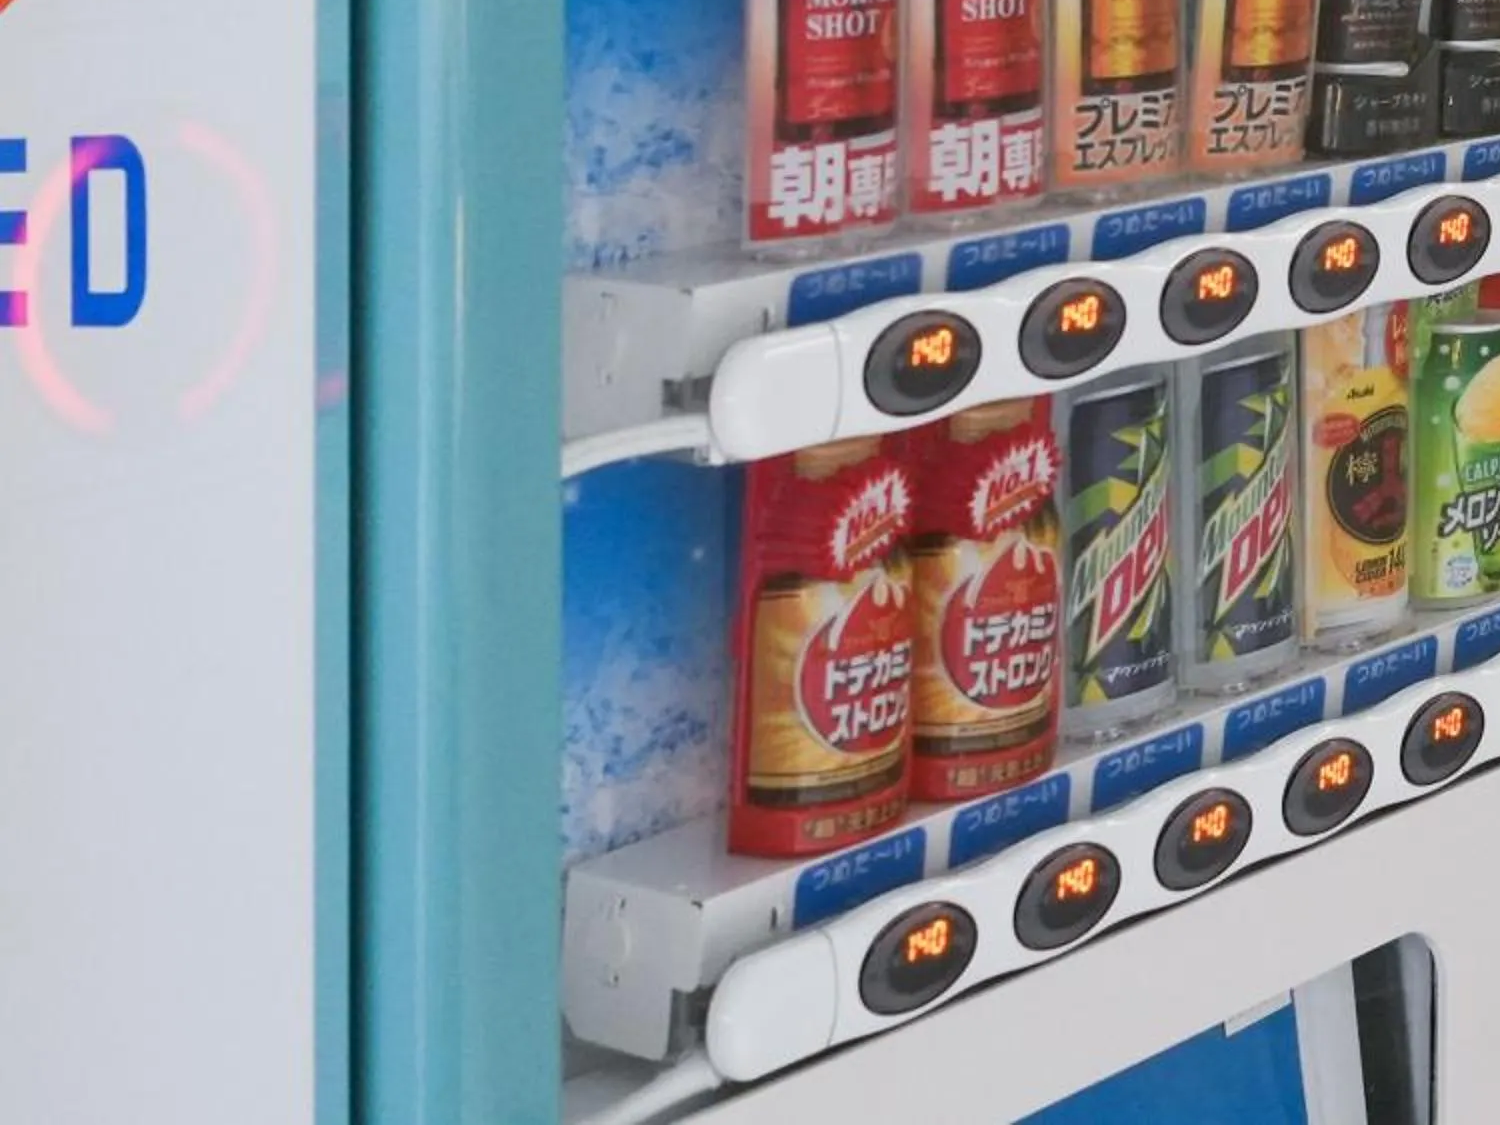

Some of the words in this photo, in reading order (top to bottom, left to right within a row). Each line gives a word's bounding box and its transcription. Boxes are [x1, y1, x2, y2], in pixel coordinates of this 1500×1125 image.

[806, 9, 880, 41] SHOT
[1440, 214, 1469, 242] 140
[1326, 238, 1356, 268] 140
[1199, 266, 1233, 298] 140
[1062, 296, 1098, 330] 140
[912, 330, 951, 364] 140
[964, 604, 1056, 656] ドデカミン
[1320, 755, 1349, 788] 140
[1194, 806, 1226, 840] 140
[1058, 860, 1093, 897] 140
[909, 920, 947, 960] 140
